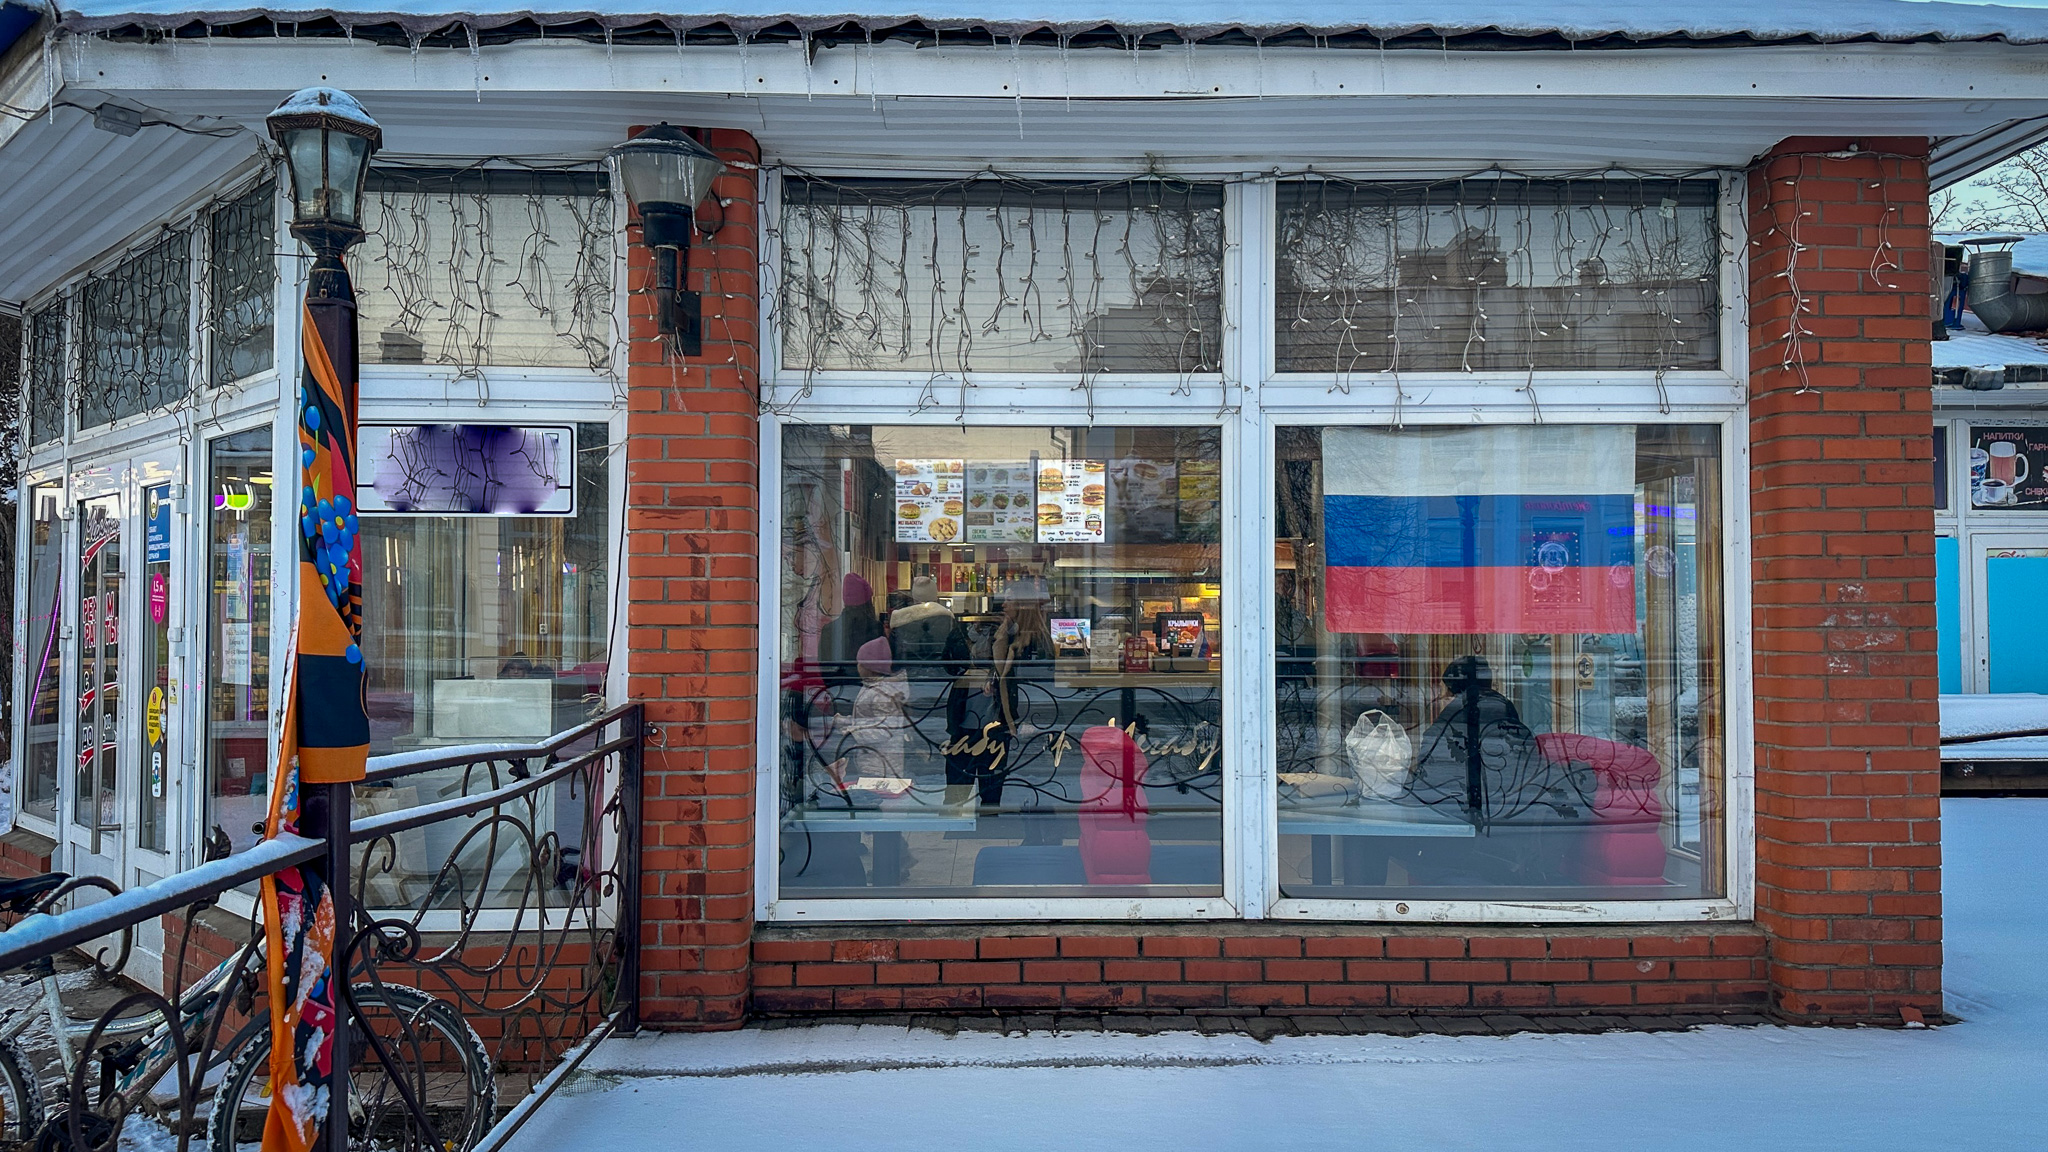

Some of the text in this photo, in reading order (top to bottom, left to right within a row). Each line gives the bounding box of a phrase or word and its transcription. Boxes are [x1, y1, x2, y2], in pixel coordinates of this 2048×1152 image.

[1983, 432, 2024, 441] НАПИТКИ
[83, 591, 114, 623] РЕМ
[84, 617, 119, 649] РАТЫ
